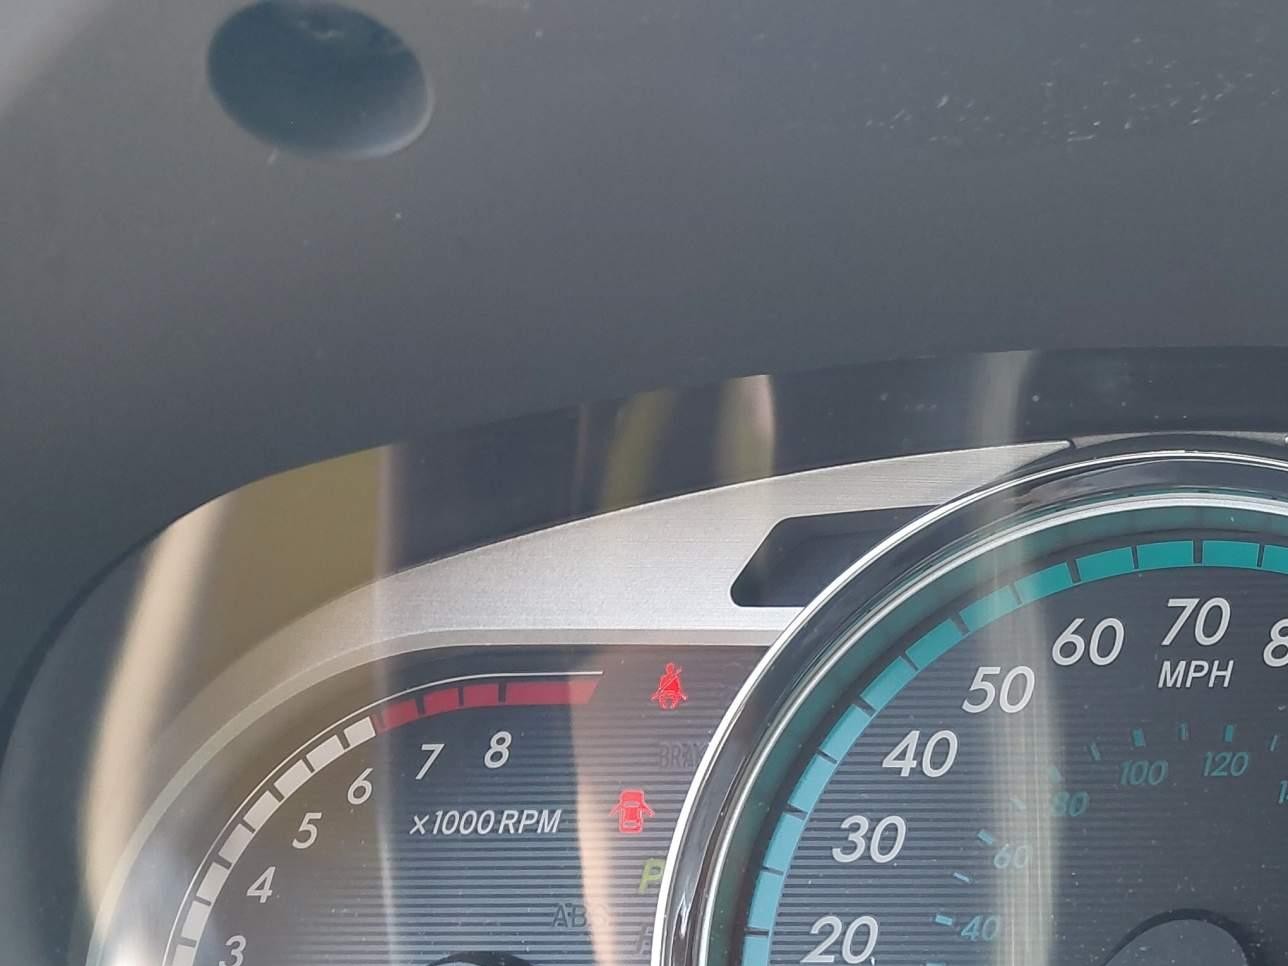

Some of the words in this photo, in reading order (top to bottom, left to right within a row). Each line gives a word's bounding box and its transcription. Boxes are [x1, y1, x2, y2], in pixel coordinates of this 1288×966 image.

[1162, 598, 1230, 645] 70
[1053, 618, 1124, 665] 60
[962, 666, 1035, 713] 50
[1159, 660, 1233, 687] MPH
[416, 744, 444, 779] 7
[485, 731, 511, 768] 8
[883, 730, 957, 777] 40
[1203, 752, 1248, 776] 120
[348, 768, 373, 804] 6
[1120, 760, 1167, 785] 100
[1053, 791, 1090, 816] 80
[293, 813, 321, 848] 5
[499, 810, 562, 834] RPM
[833, 816, 906, 862] 30
[994, 844, 1028, 869] 60
[247, 867, 275, 903] 4
[638, 858, 667, 894] P
[801, 916, 878, 963] 20
[960, 915, 999, 941] 40
